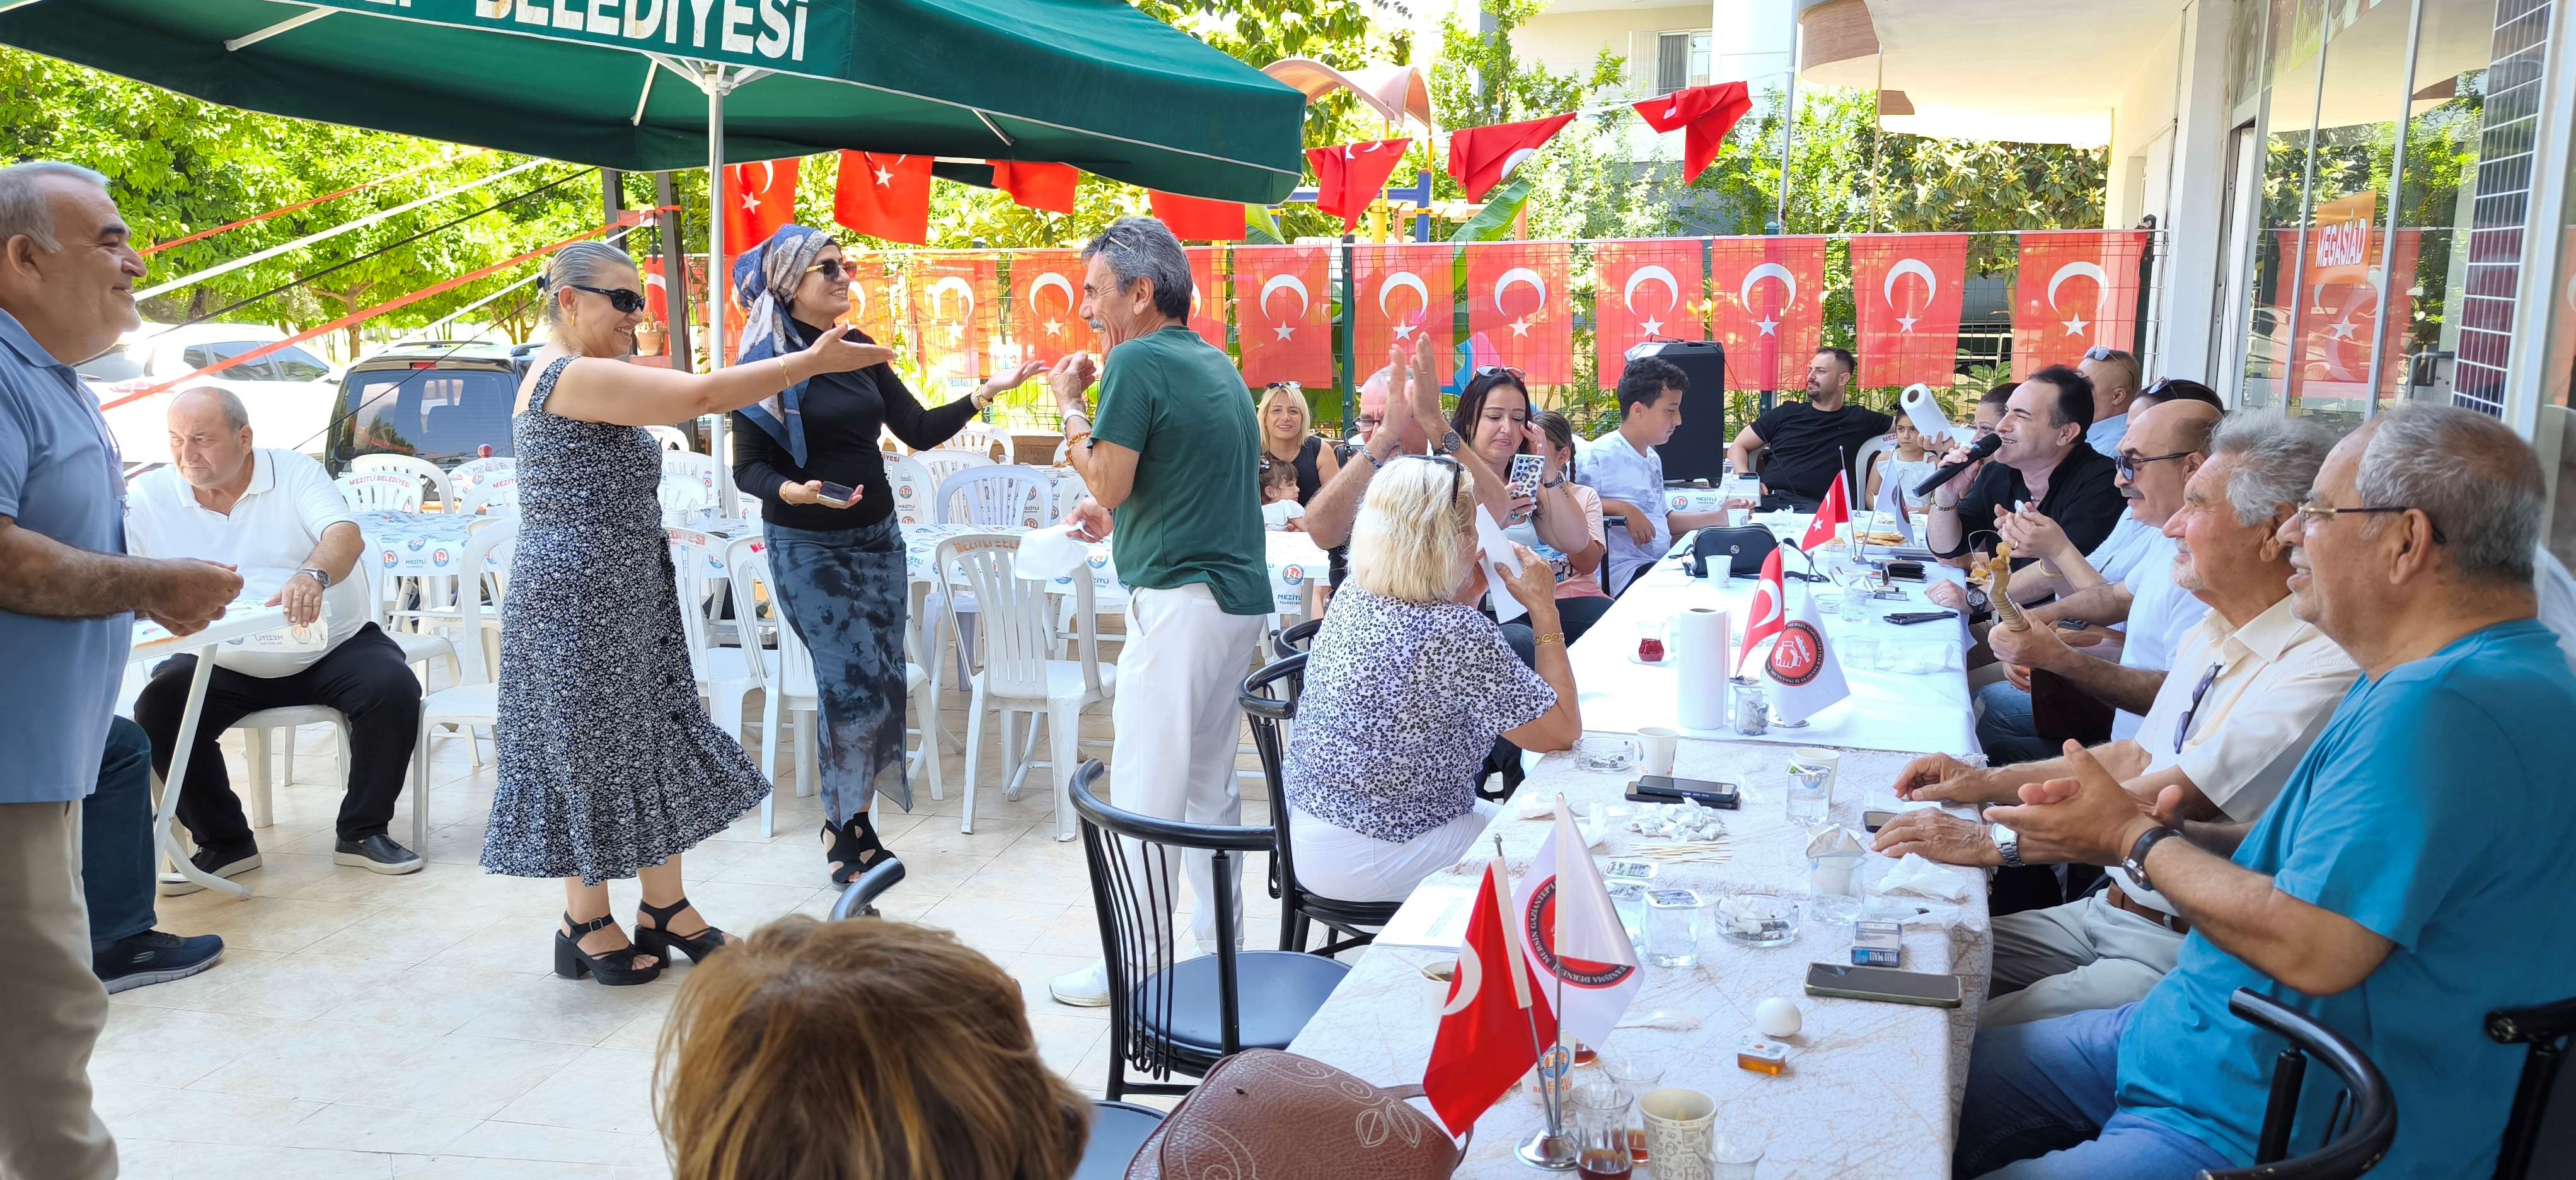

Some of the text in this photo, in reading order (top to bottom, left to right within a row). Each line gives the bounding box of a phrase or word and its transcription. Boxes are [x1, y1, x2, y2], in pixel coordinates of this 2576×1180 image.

[2316, 207, 2366, 268] MEGASİAD
[349, 474, 376, 485] MEZİTLİ
[1530, 882, 1556, 964] MERSİN GAZİANTEP'L
[1869, 952, 1897, 963] PALL MALL
[1552, 963, 1591, 984] DERNEİ
